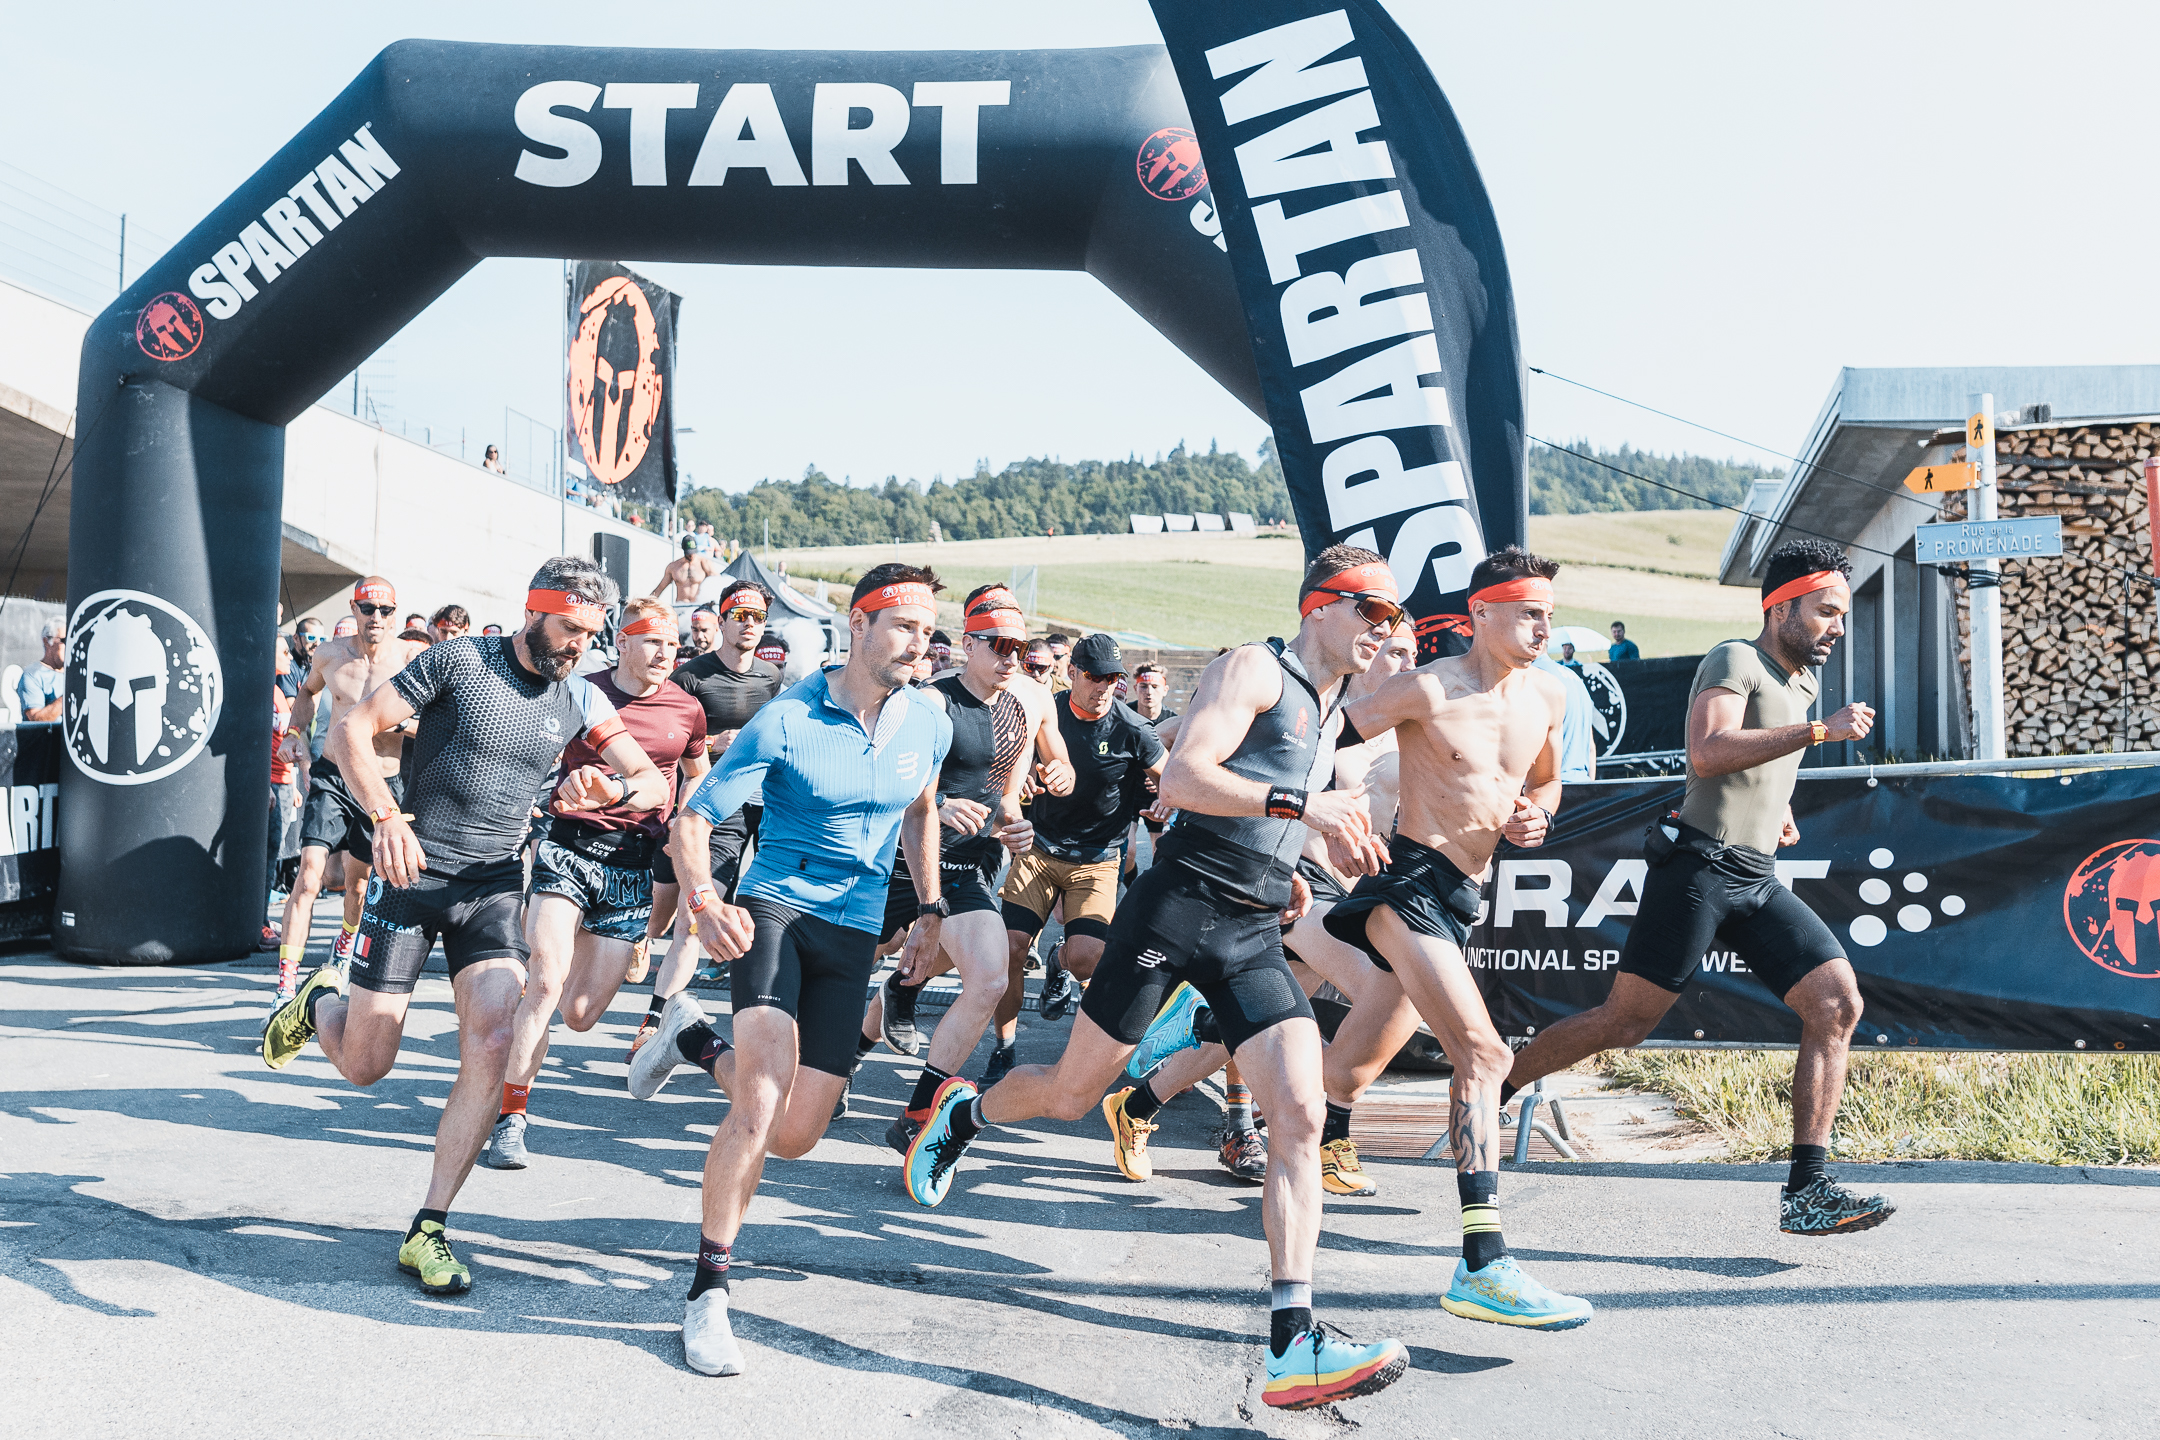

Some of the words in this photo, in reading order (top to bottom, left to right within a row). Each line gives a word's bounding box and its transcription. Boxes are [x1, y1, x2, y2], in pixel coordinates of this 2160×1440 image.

[513, 80, 1012, 188] START
[187, 124, 402, 320] SPARTAN
[1204, 8, 1488, 605] SPARTAN
[1961, 524, 1985, 537] Rue
[1990, 525, 2002, 535] de
[2005, 524, 2014, 534] la
[1935, 534, 2043, 557] PROMENADE
[586, 846, 610, 857] RESS
[592, 841, 617, 852] COMP
[362, 911, 378, 925] OCR
[381, 919, 416, 936] TEAM
[1464, 947, 1576, 971] UNCTIONAL
[1460, 1273, 1520, 1307] HOKA
